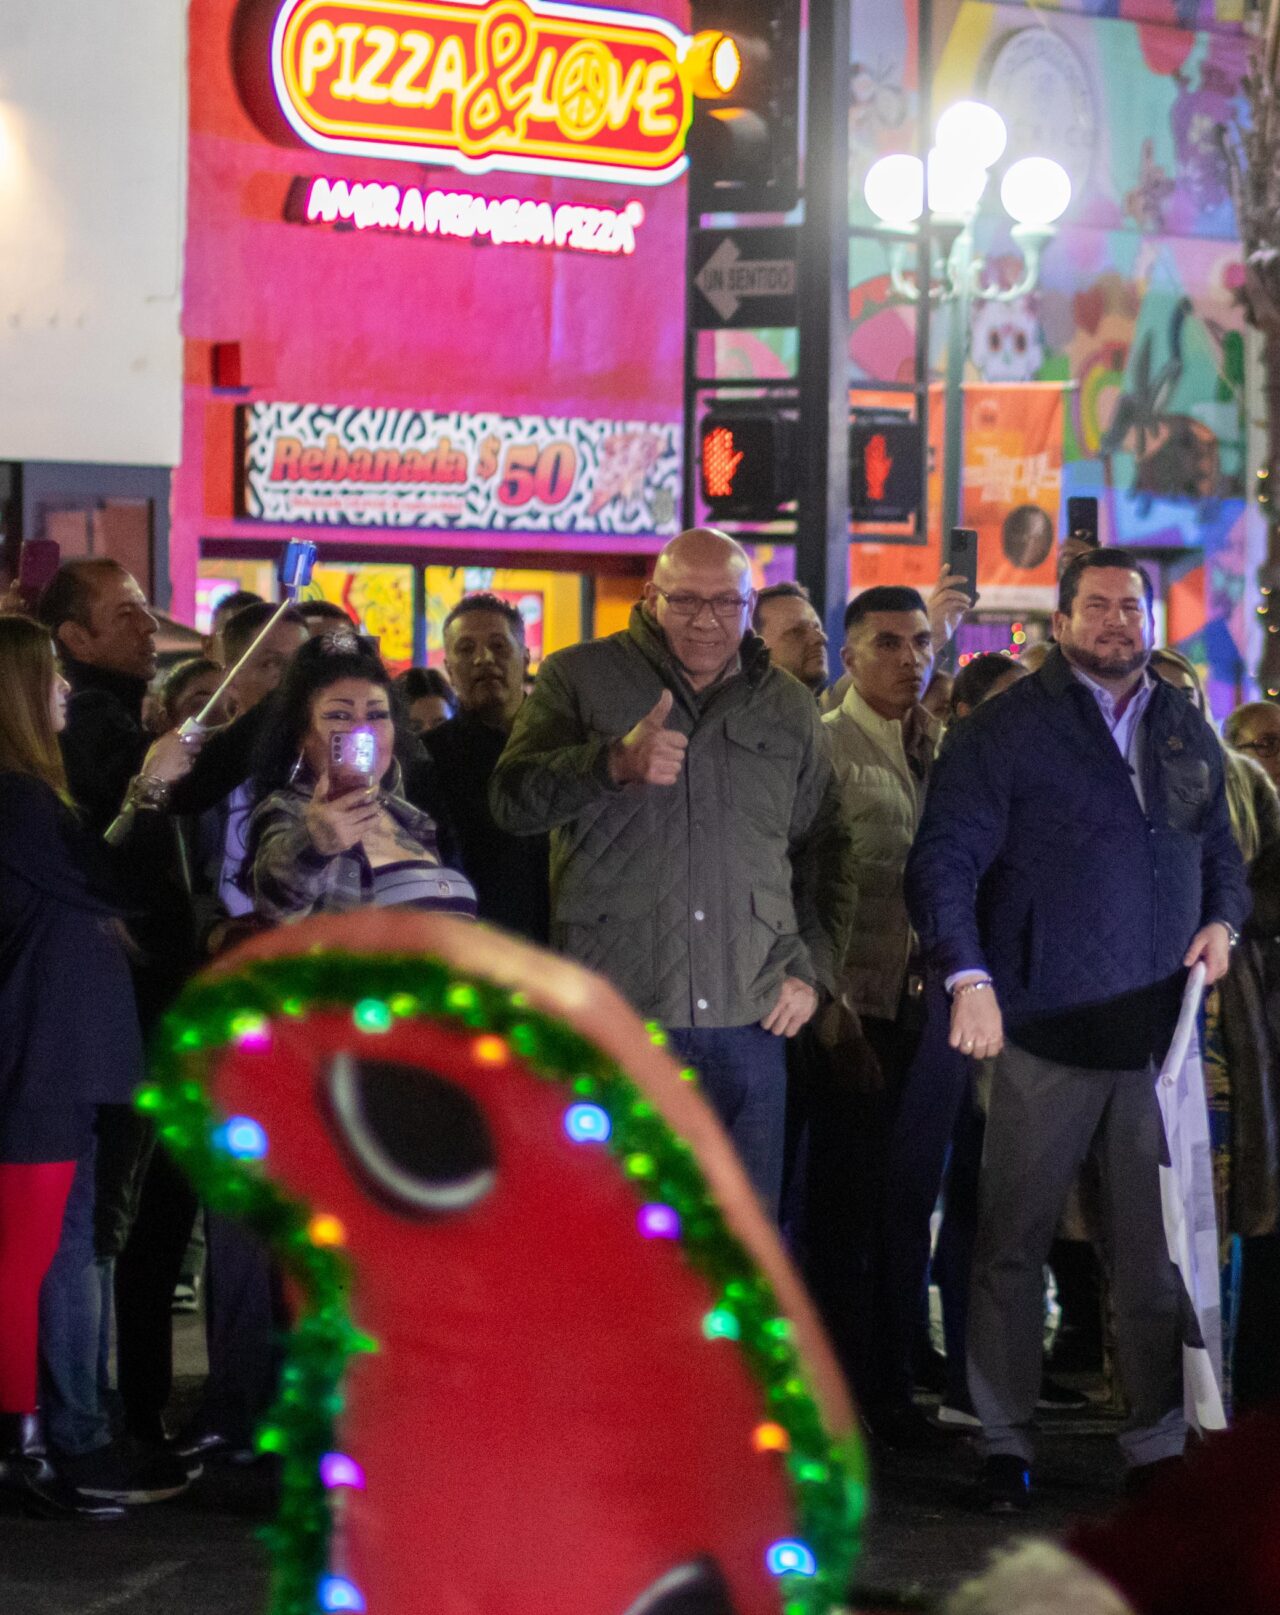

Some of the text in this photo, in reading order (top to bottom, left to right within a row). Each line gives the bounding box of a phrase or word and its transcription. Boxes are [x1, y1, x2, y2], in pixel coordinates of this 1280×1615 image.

[301, 19, 468, 109] PIZZA
[520, 39, 681, 141] LOVE
[728, 265, 791, 292] SENTIDO
[270, 426, 468, 485] Rebanada
